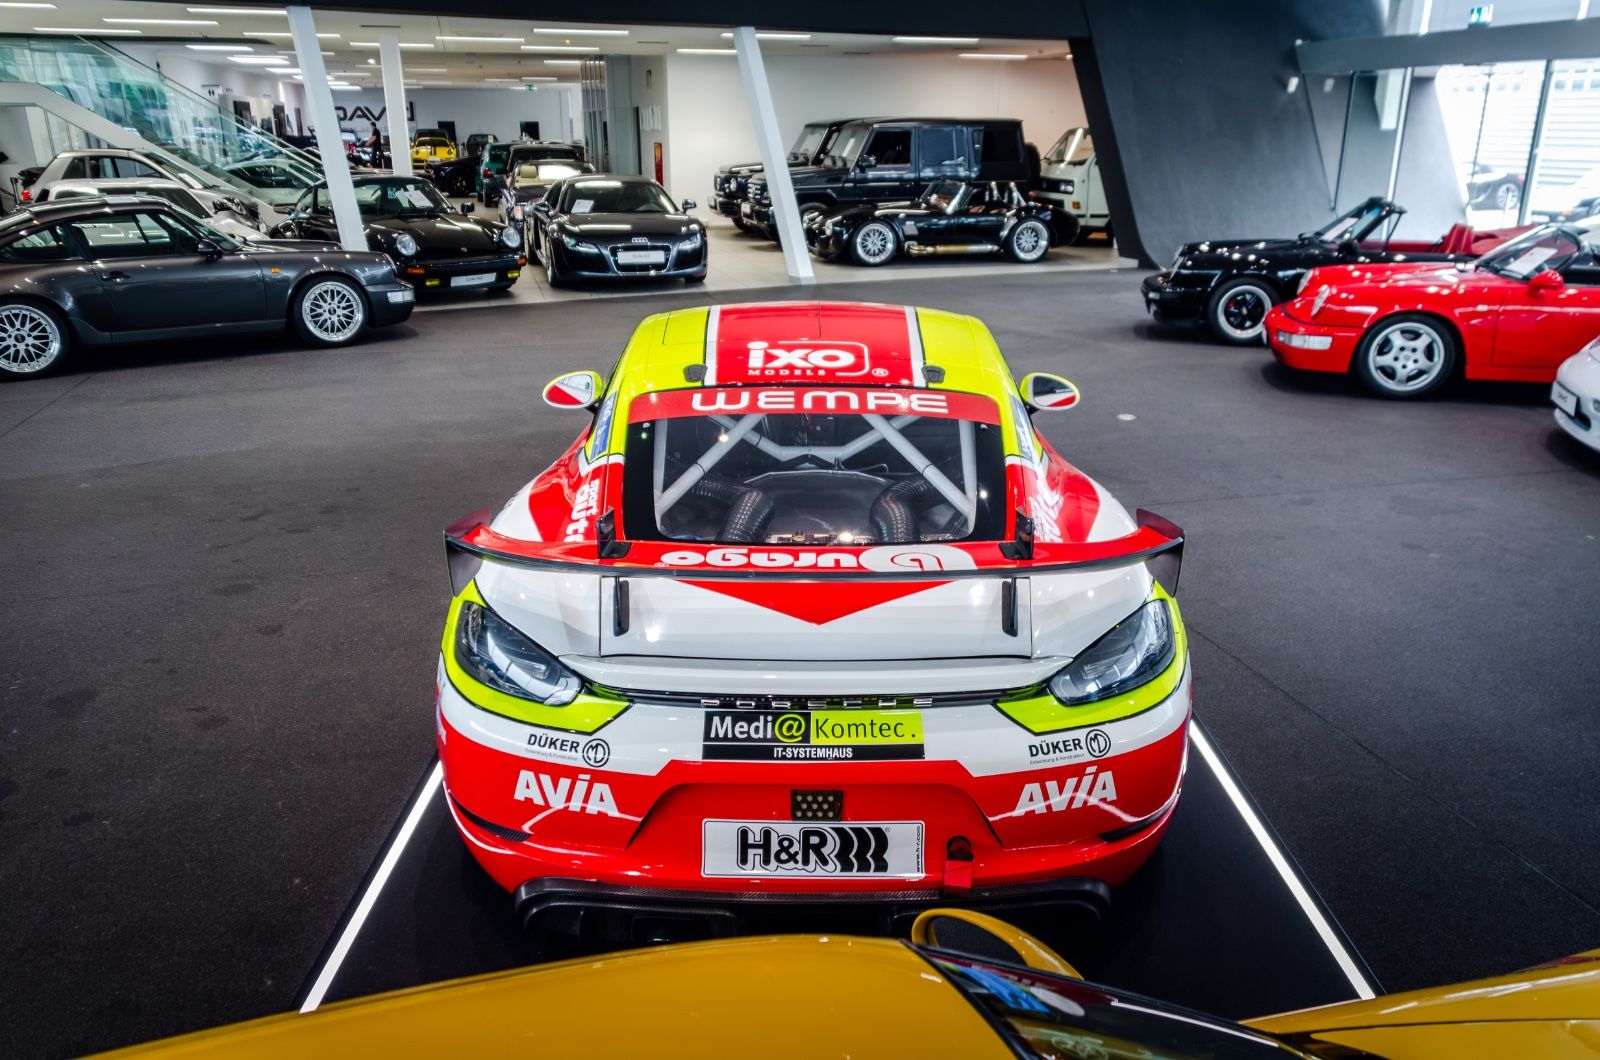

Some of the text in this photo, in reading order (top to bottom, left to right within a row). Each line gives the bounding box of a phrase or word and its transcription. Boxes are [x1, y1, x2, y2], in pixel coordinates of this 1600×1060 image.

[691, 390, 949, 414] WEMPE
[527, 733, 580, 754] DÜKER
[773, 747, 853, 759] IT-SYSTEMHAUS
[1028, 739, 1084, 758] DÜKER
[738, 826, 837, 872] H&R
